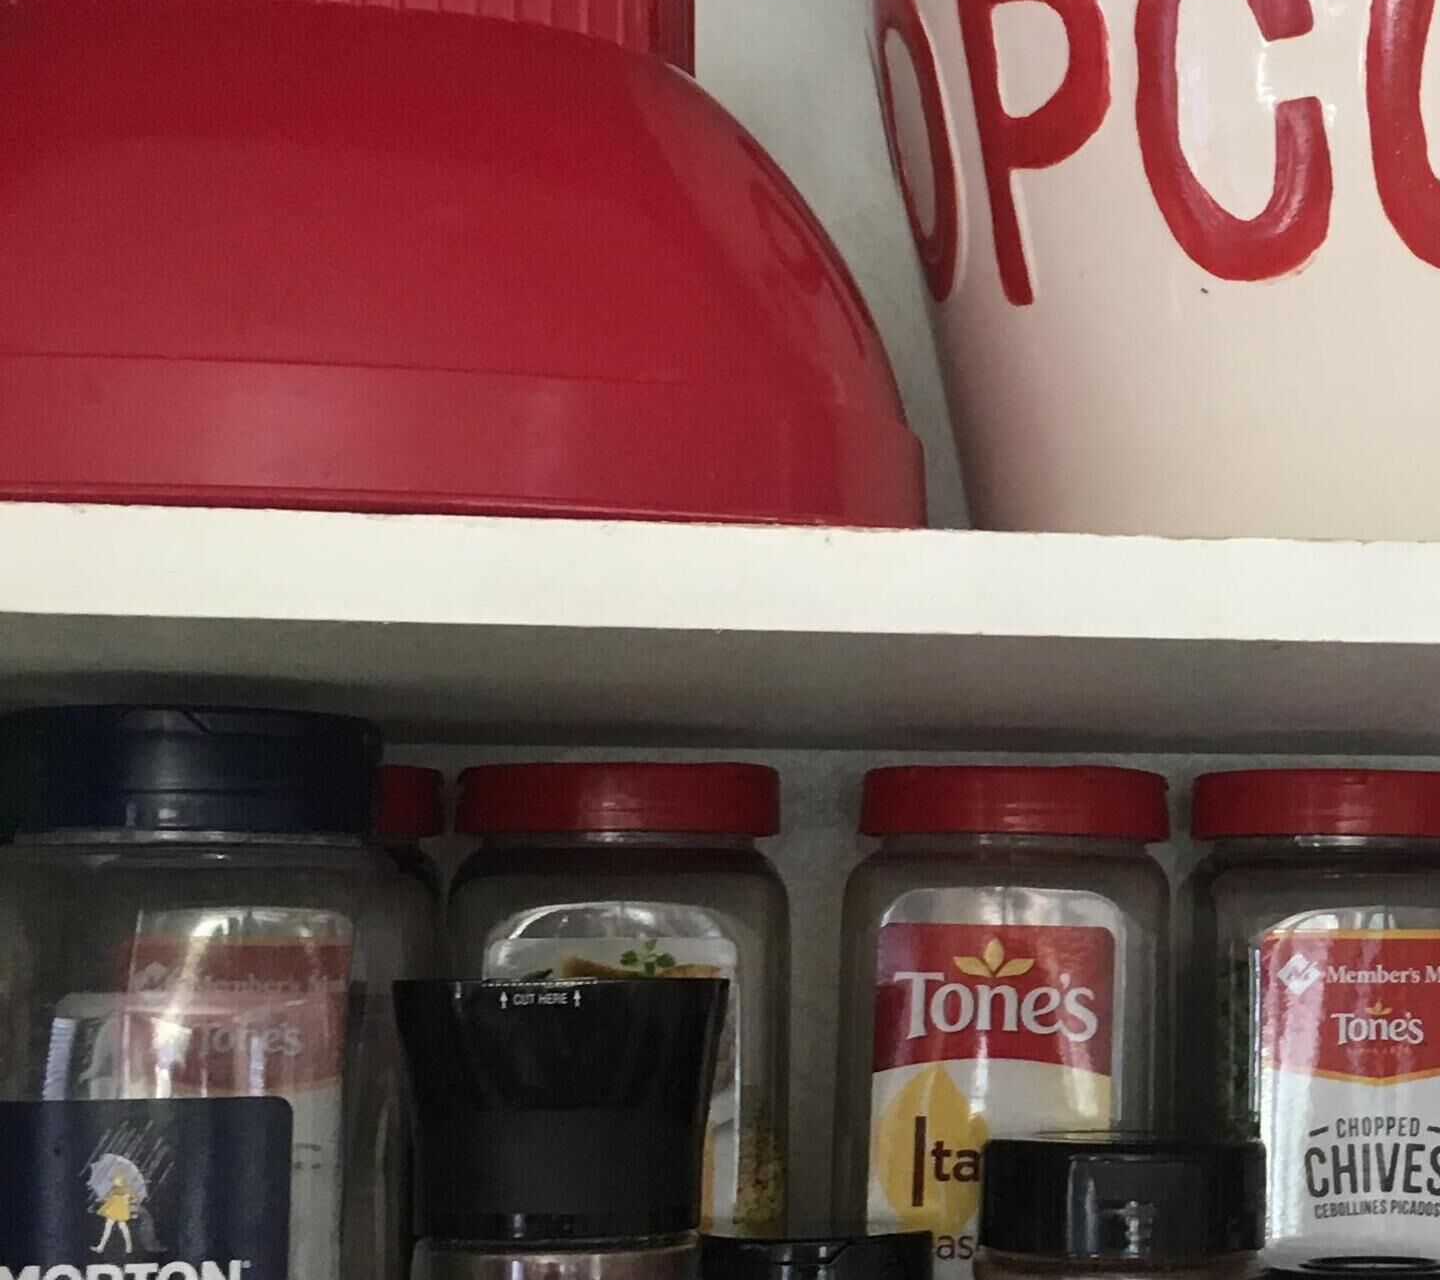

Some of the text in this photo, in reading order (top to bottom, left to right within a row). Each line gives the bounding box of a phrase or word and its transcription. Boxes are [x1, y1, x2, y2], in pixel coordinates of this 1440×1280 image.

[1326, 966, 1420, 984] Member's
[513, 992, 567, 1007] CUT HERE
[894, 972, 1098, 1042] Tone's
[1330, 1010, 1425, 1045] Tone's
[1336, 1116, 1420, 1138] CHOPPED
[1390, 1200, 1440, 1217] PICADOS
